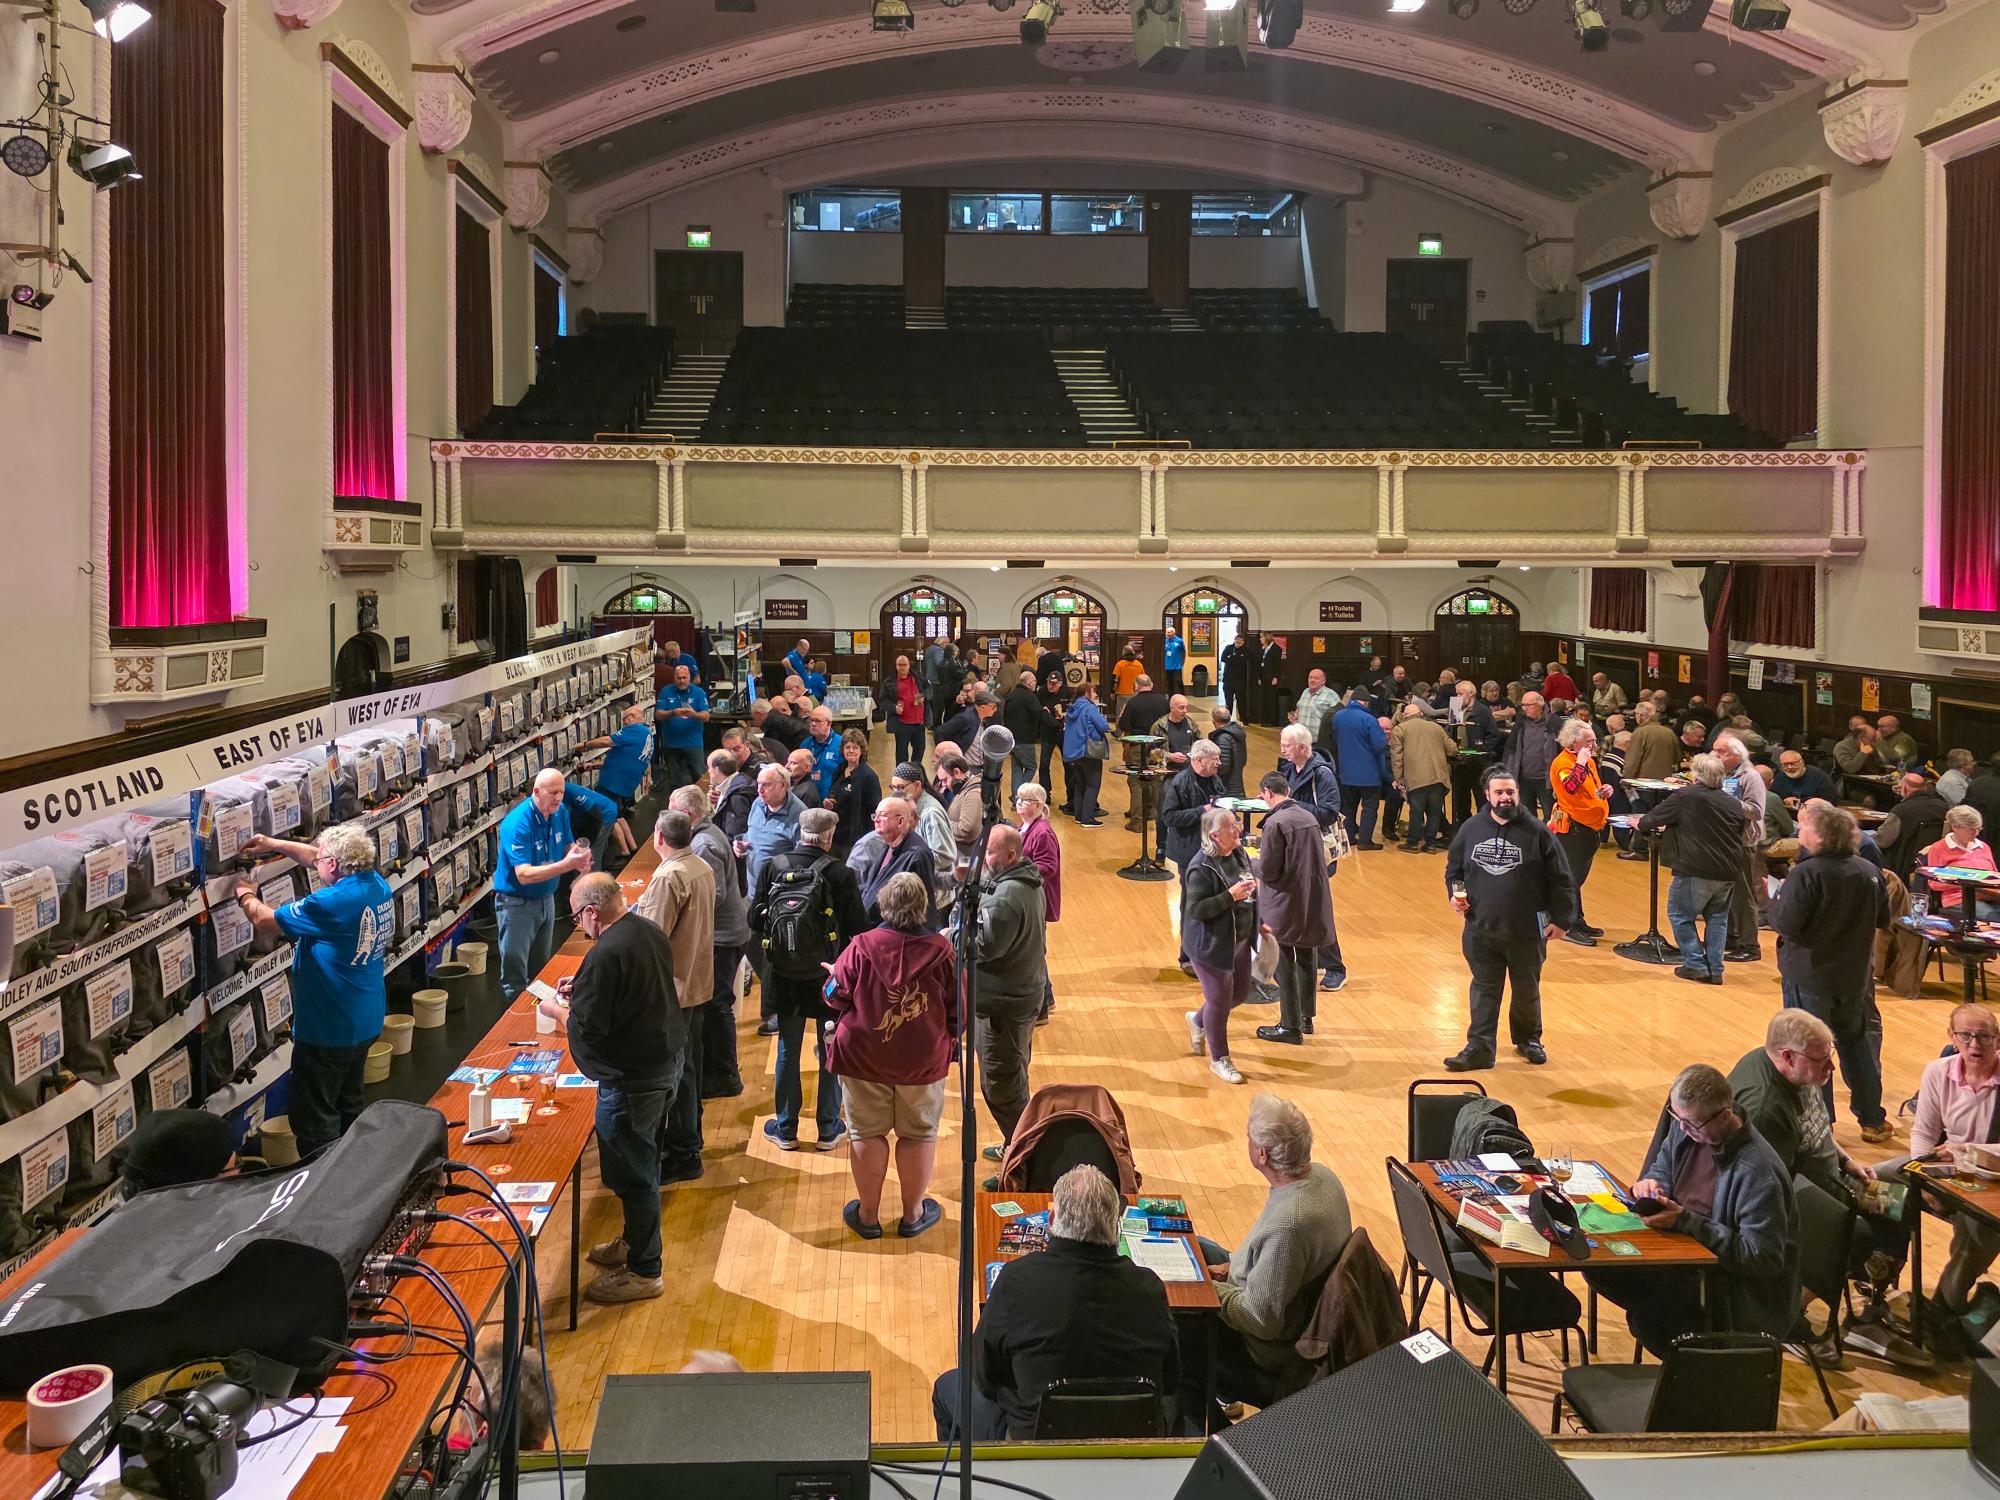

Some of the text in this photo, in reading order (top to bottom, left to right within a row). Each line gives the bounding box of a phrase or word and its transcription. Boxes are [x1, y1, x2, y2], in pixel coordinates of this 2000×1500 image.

[505, 661, 527, 680] BLACK
[563, 647, 577, 662] WEST
[578, 643, 598, 657] MIDLANDS
[349, 692, 422, 726] WEST OF EYA
[213, 716, 323, 770] EAST OF EYA
[24, 766, 164, 830] SCOTLAND
[0, 980, 33, 1011] UDLEY
[35, 970, 57, 993] AND
[60, 953, 93, 980] SOUTH
[94, 915, 162, 962] STAFFORDSHIRE
[161, 902, 187, 925] CAMRA
[210, 947, 294, 1007] WELCOME TO DUDLEY WIN
[69, 1193, 108, 1230] DUDLEY
